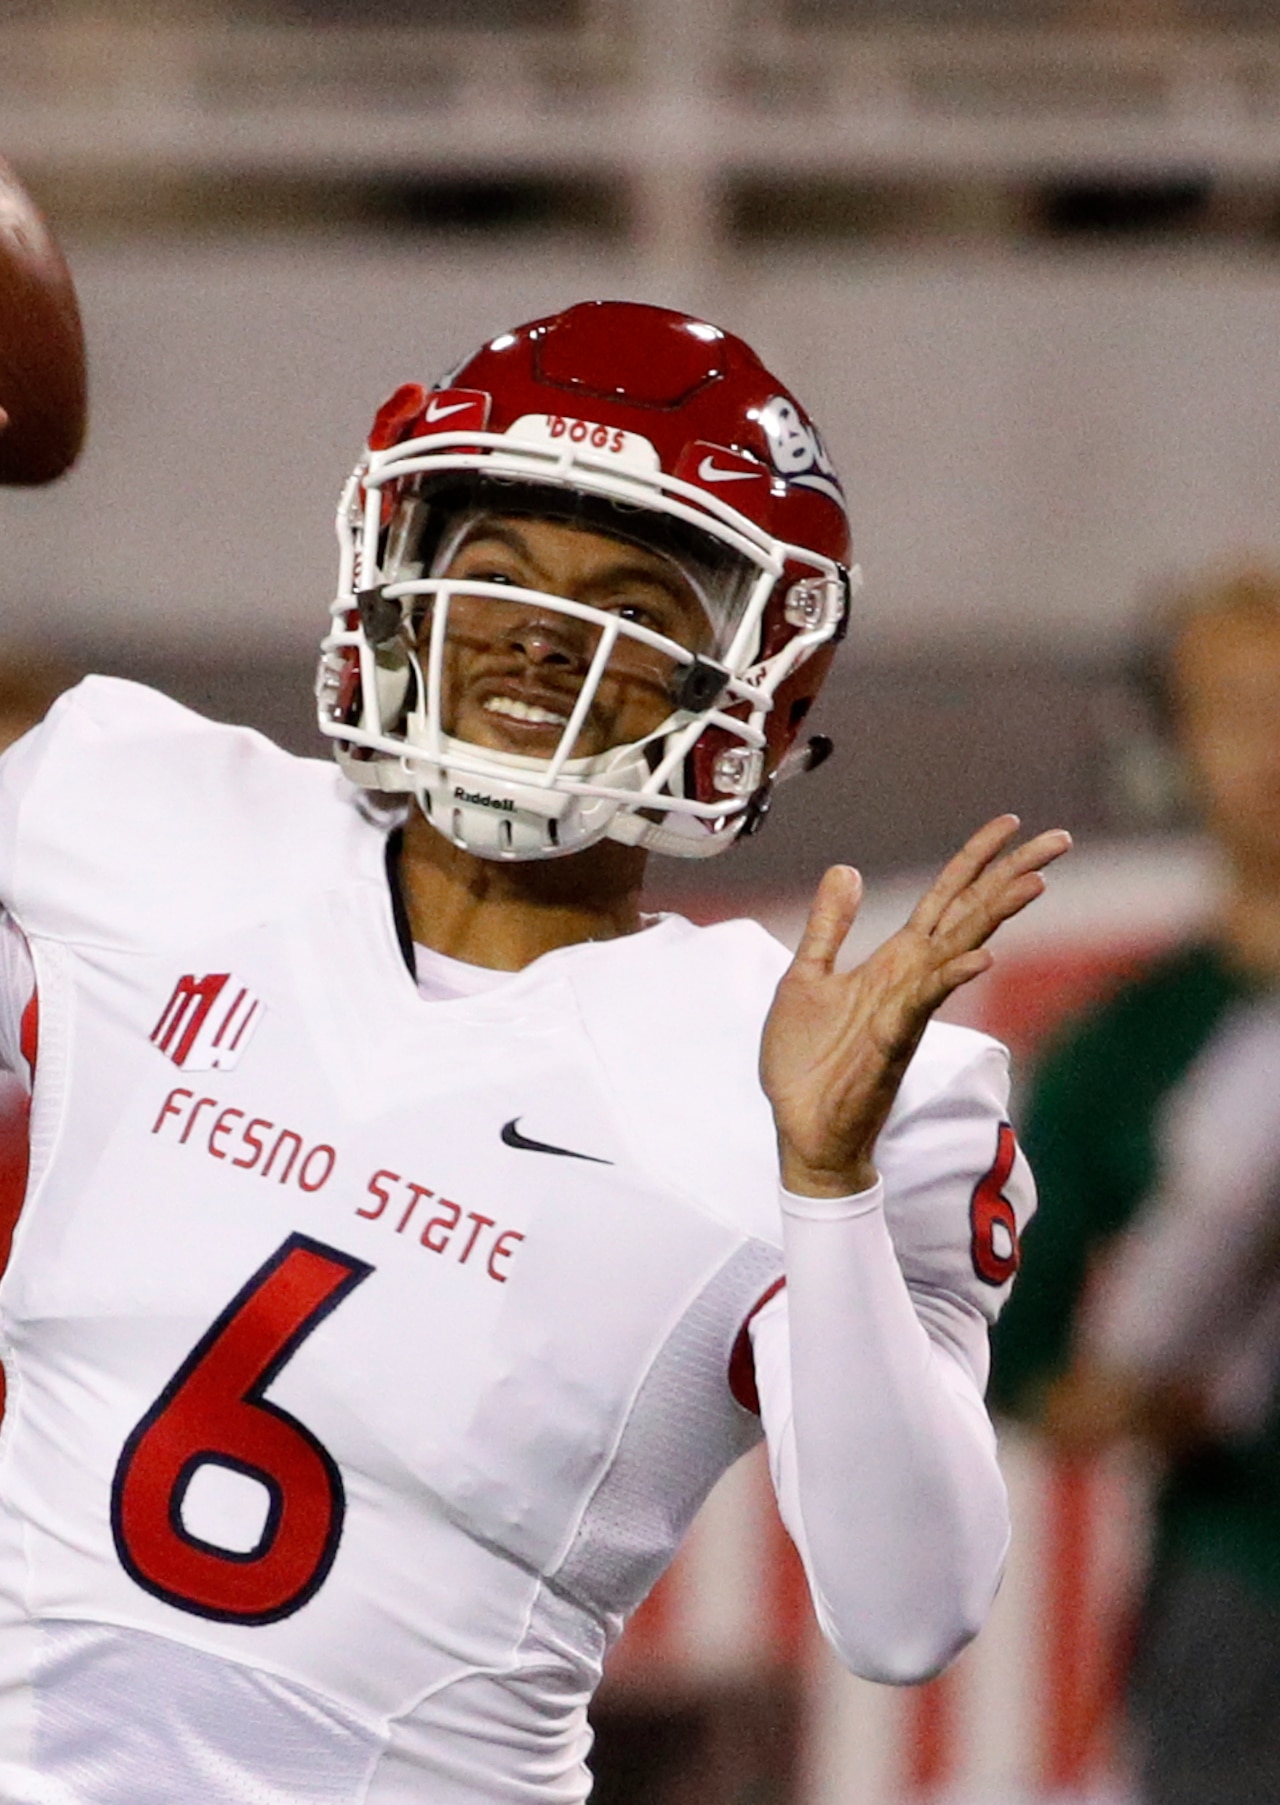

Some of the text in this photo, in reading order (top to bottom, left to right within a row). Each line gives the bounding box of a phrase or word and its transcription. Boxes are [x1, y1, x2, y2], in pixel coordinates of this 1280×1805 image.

[453, 786, 515, 812] Riddell
[969, 1120, 1021, 1286] 6
[109, 1231, 376, 1628] 6
